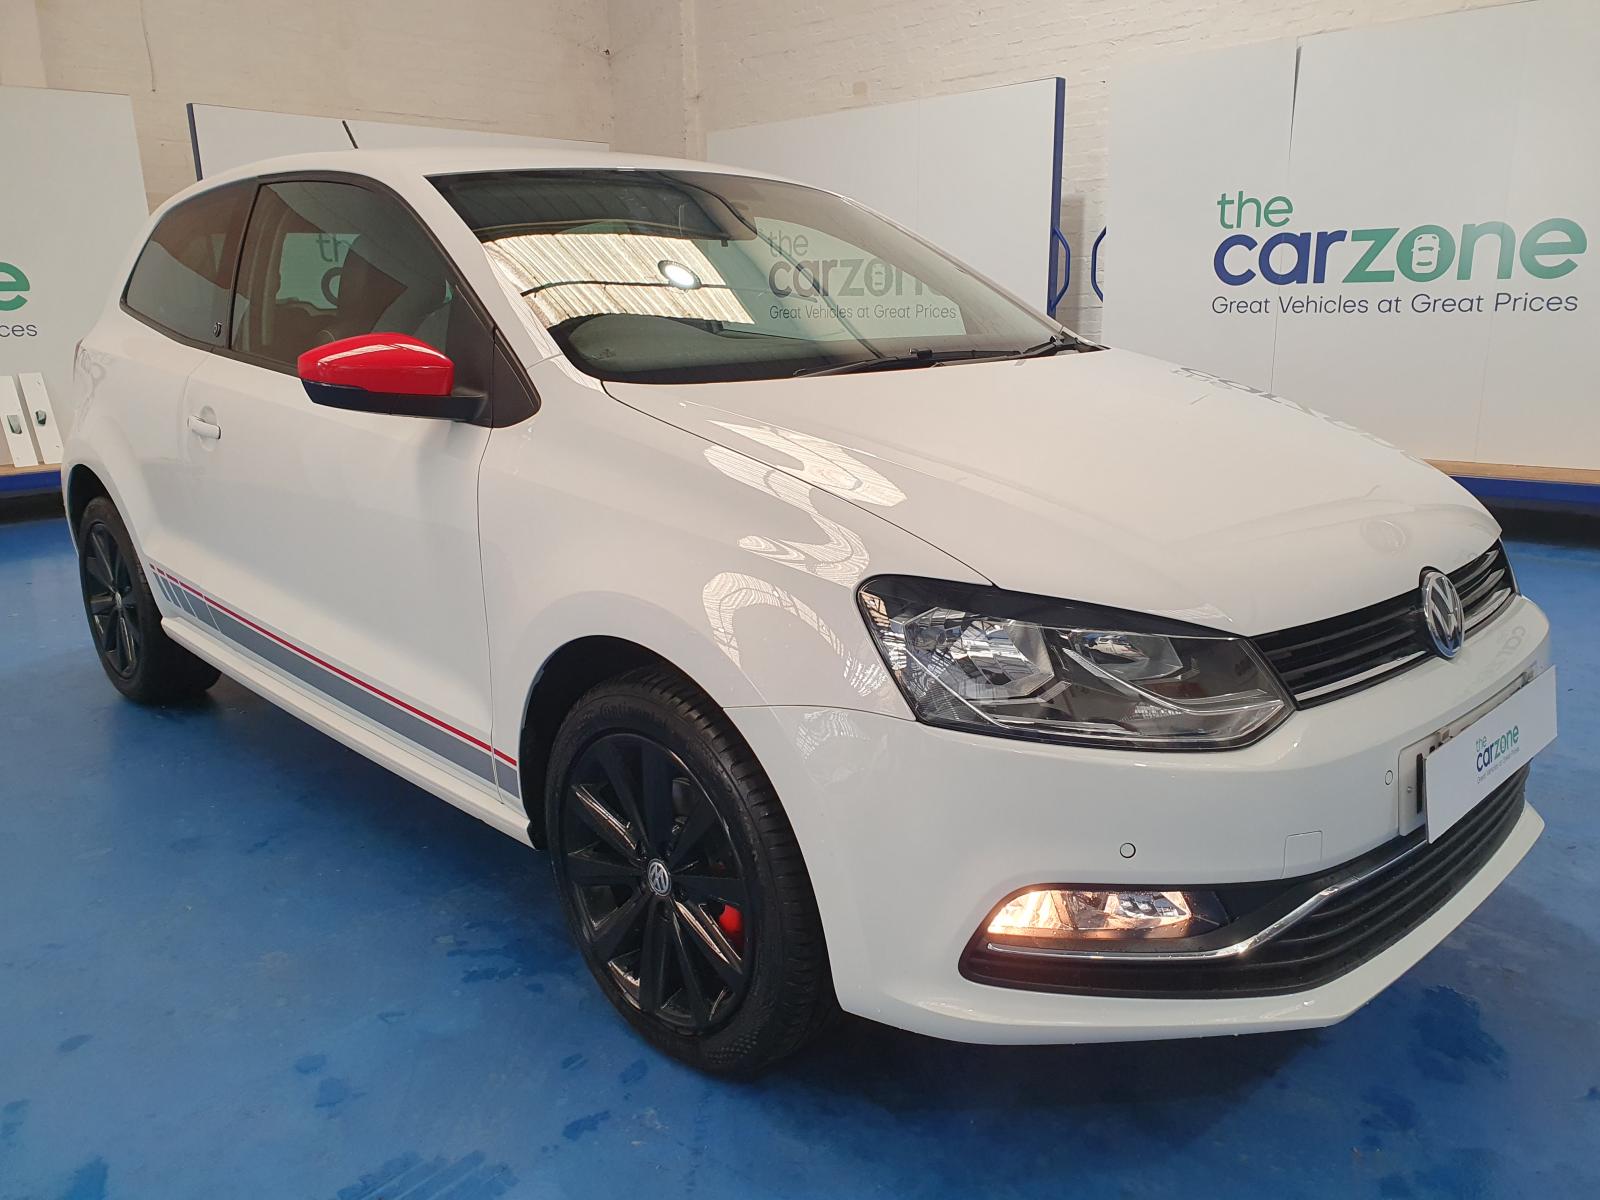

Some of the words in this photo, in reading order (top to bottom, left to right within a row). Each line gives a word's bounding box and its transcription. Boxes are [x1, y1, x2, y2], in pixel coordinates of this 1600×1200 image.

[1216, 190, 1294, 229] the
[768, 230, 809, 257] the
[1213, 217, 1588, 287] carzone
[769, 258, 944, 298] carzon
[769, 305, 801, 320] Great
[805, 304, 853, 319] Vehicles
[857, 306, 870, 319] at
[874, 304, 910, 319] Great
[915, 304, 957, 319] Prices
[1212, 296, 1270, 314] Great
[1278, 295, 1369, 314] Vehicles
[1377, 296, 1402, 314] at
[1411, 293, 1484, 313] Great
[1494, 292, 1579, 312] Prices
[1476, 725, 1520, 773] carzone
